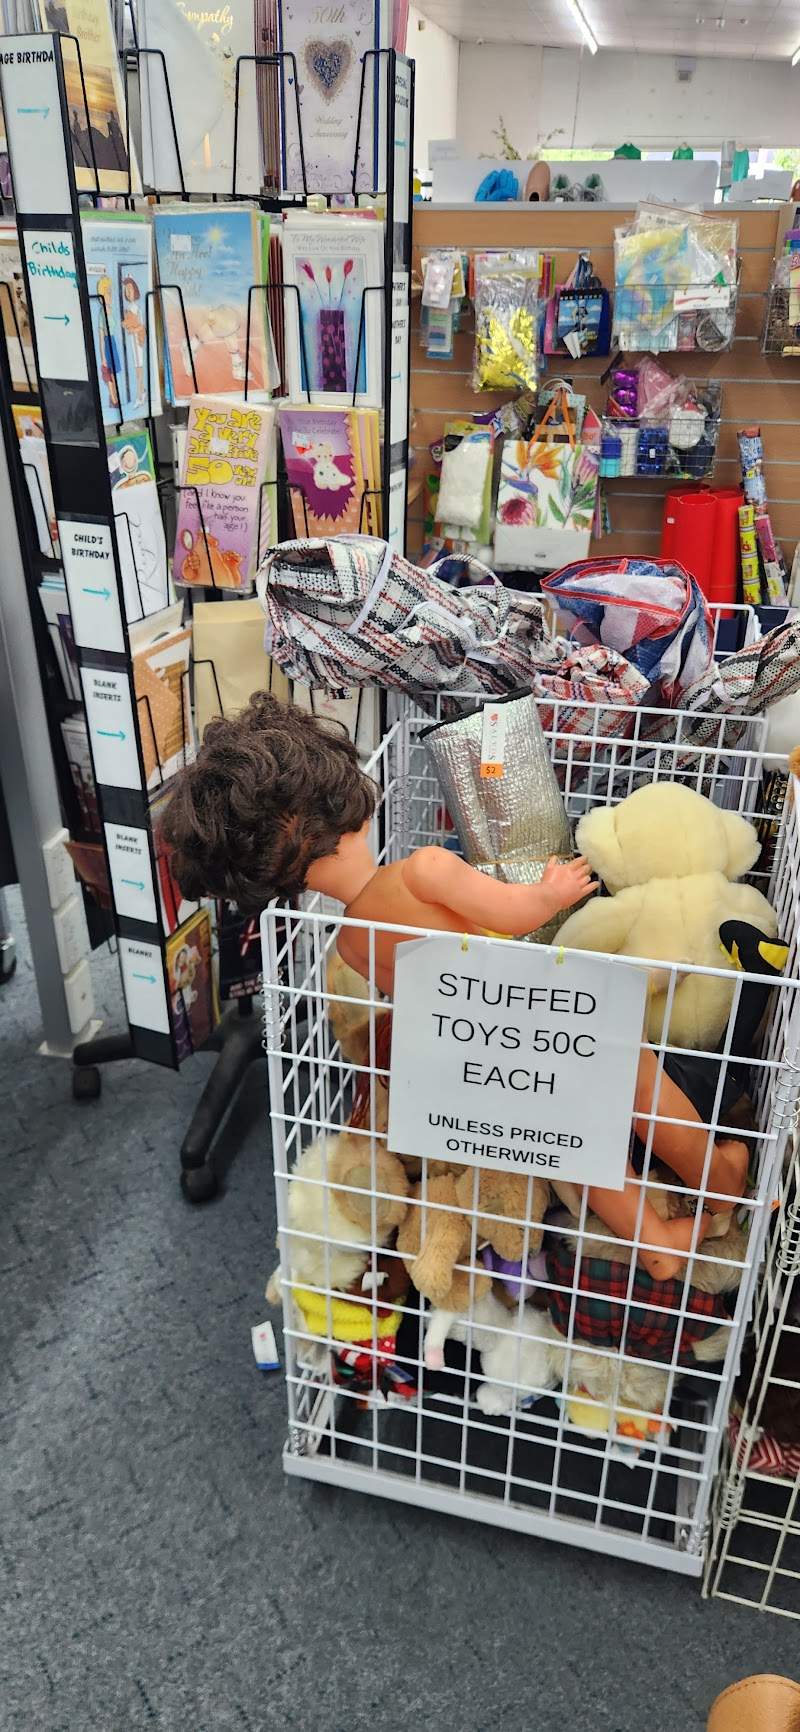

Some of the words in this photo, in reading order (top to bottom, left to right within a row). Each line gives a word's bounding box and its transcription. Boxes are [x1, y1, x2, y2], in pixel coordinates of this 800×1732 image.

[176, 2, 234, 33] Sympathy
[17, 50, 54, 64] BIRTHDA
[32, 242, 71, 256] Childs
[192, 408, 228, 432] You
[227, 408, 262, 431] are
[218, 426, 260, 448] very
[184, 456, 234, 485] 50
[211, 488, 231, 500] know
[233, 495, 246, 503] you
[185, 501, 200, 510] fee
[222, 504, 249, 515] person
[74, 533, 104, 545] CHILD'S
[71, 547, 110, 560] BIRTHDAY
[93, 678, 118, 690] BLANK
[93, 691, 122, 703] INSERTS
[116, 833, 139, 845] BLANK
[115, 844, 143, 856] INSERTS
[438, 973, 597, 1015] STUFFED
[432, 1013, 521, 1050] TOYS
[533, 1029, 597, 1058] 50C
[463, 1061, 556, 1095] EACH
[428, 1113, 504, 1138] UNLESS
[510, 1127, 584, 1149] PRICED
[446, 1138, 561, 1169] OTHERWISE
